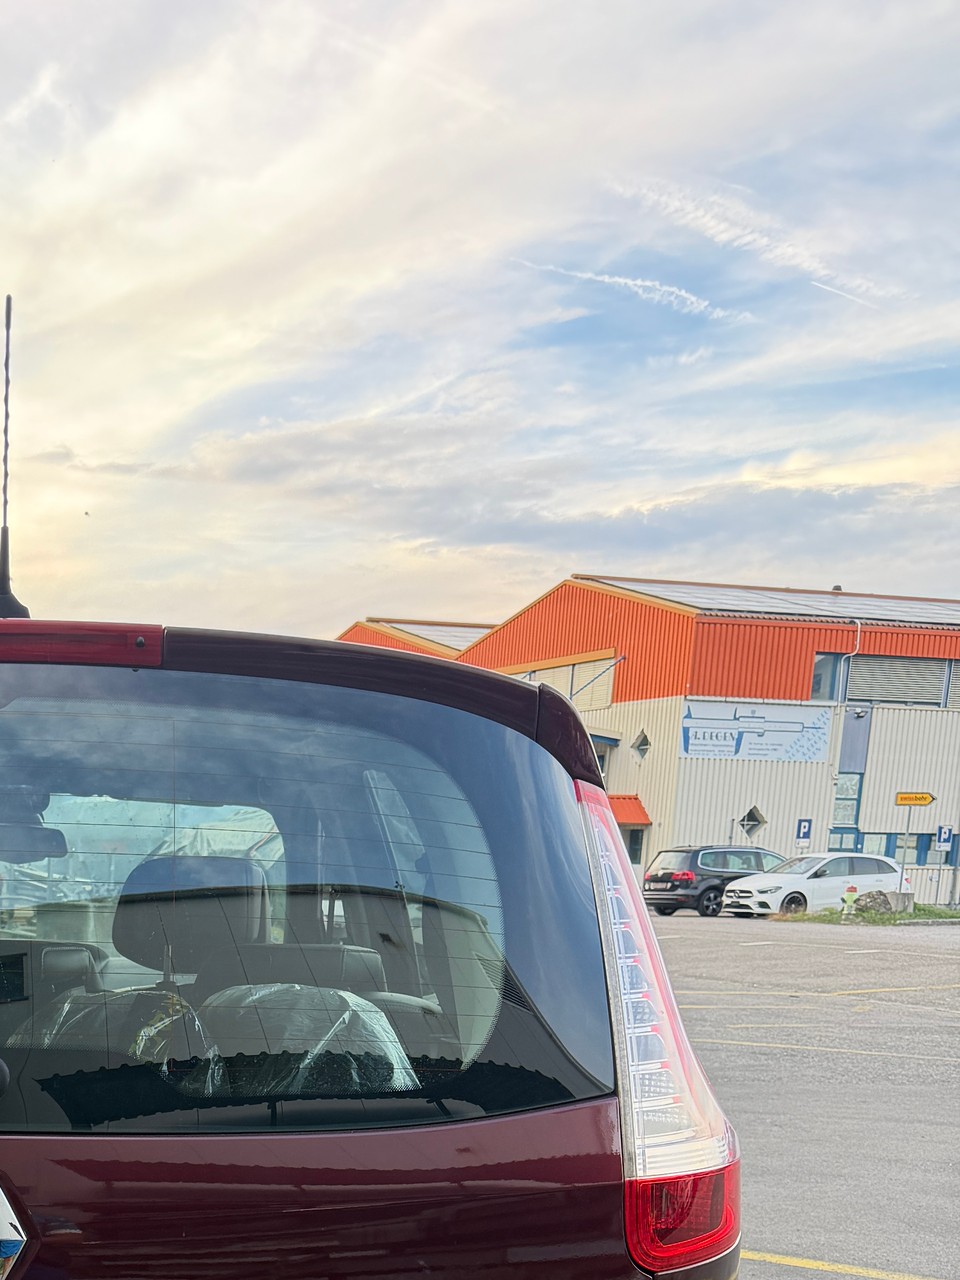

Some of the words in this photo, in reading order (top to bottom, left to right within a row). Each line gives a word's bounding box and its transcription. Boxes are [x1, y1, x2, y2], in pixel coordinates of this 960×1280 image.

[702, 731, 737, 742] DEGEN
[800, 821, 809, 838] P
[940, 827, 949, 842] P
